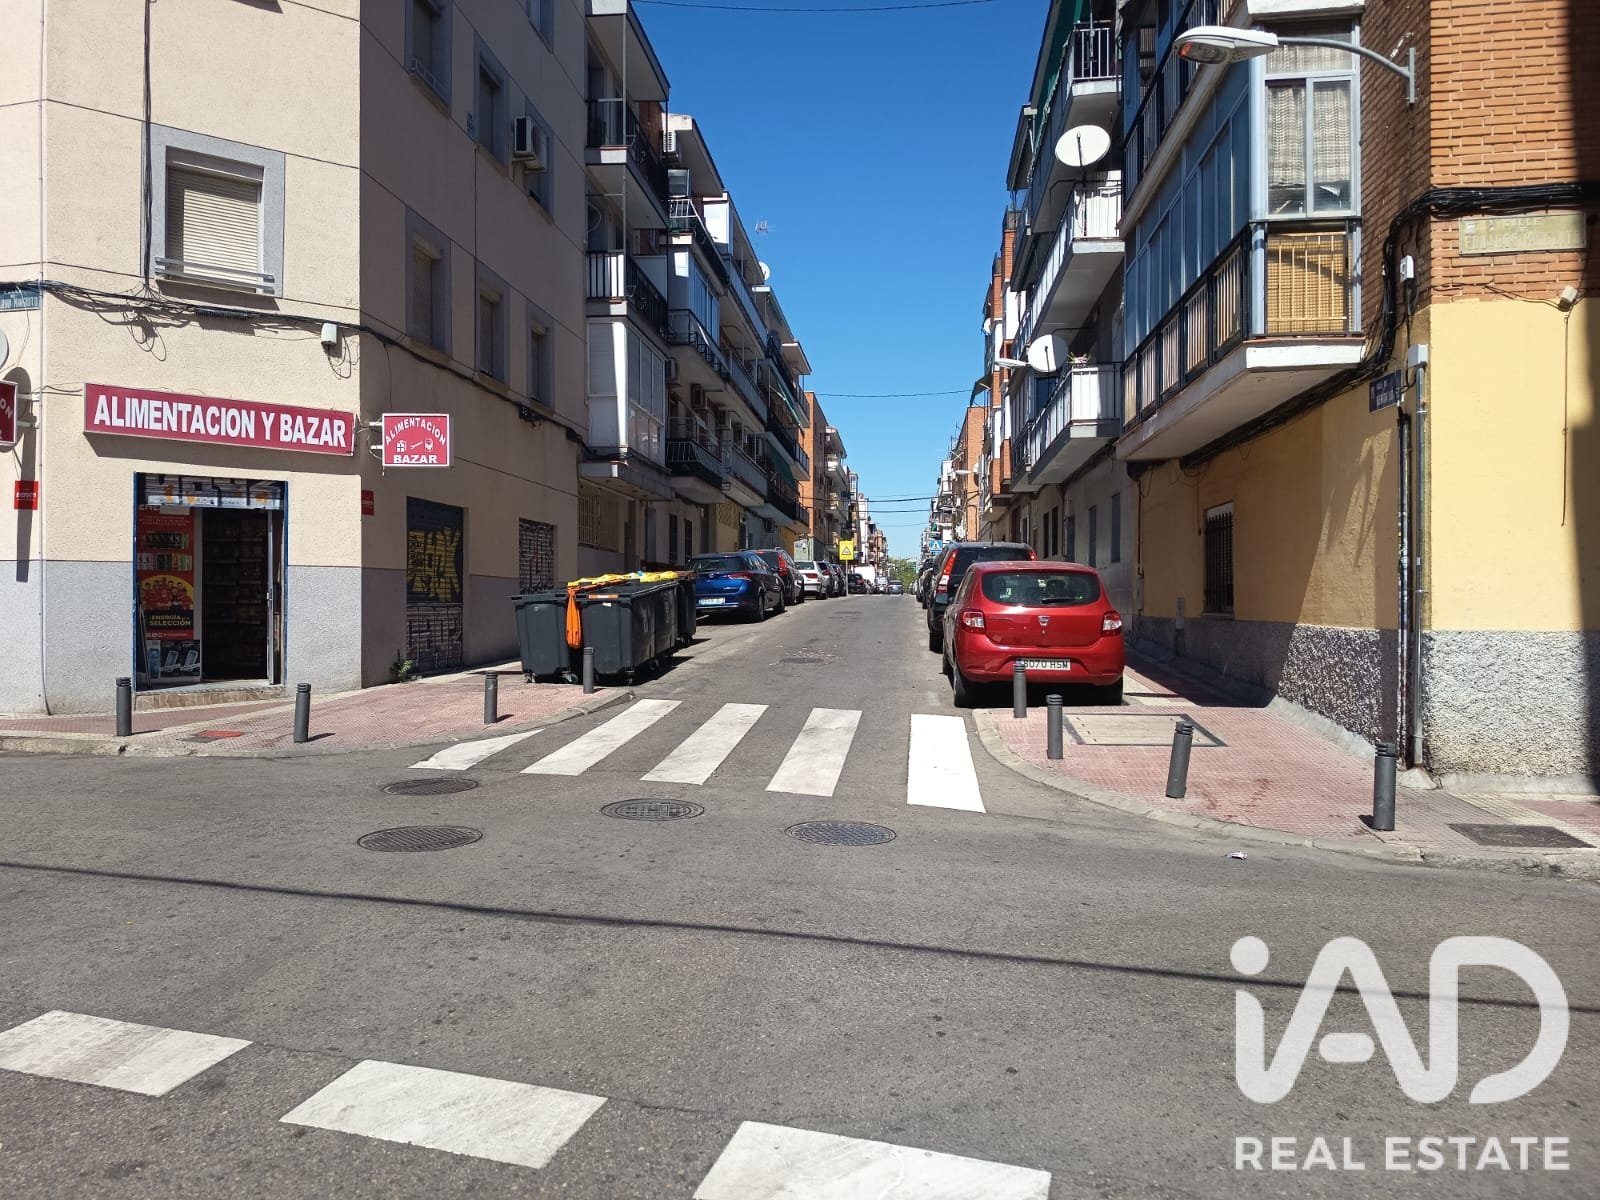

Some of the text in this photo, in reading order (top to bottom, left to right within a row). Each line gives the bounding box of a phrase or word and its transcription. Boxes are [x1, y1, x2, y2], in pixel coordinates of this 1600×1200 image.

[93, 394, 346, 448] ALIMENTACION Y BAZAR
[385, 417, 446, 446] ALIMENTACION
[393, 454, 438, 464] BAZAR
